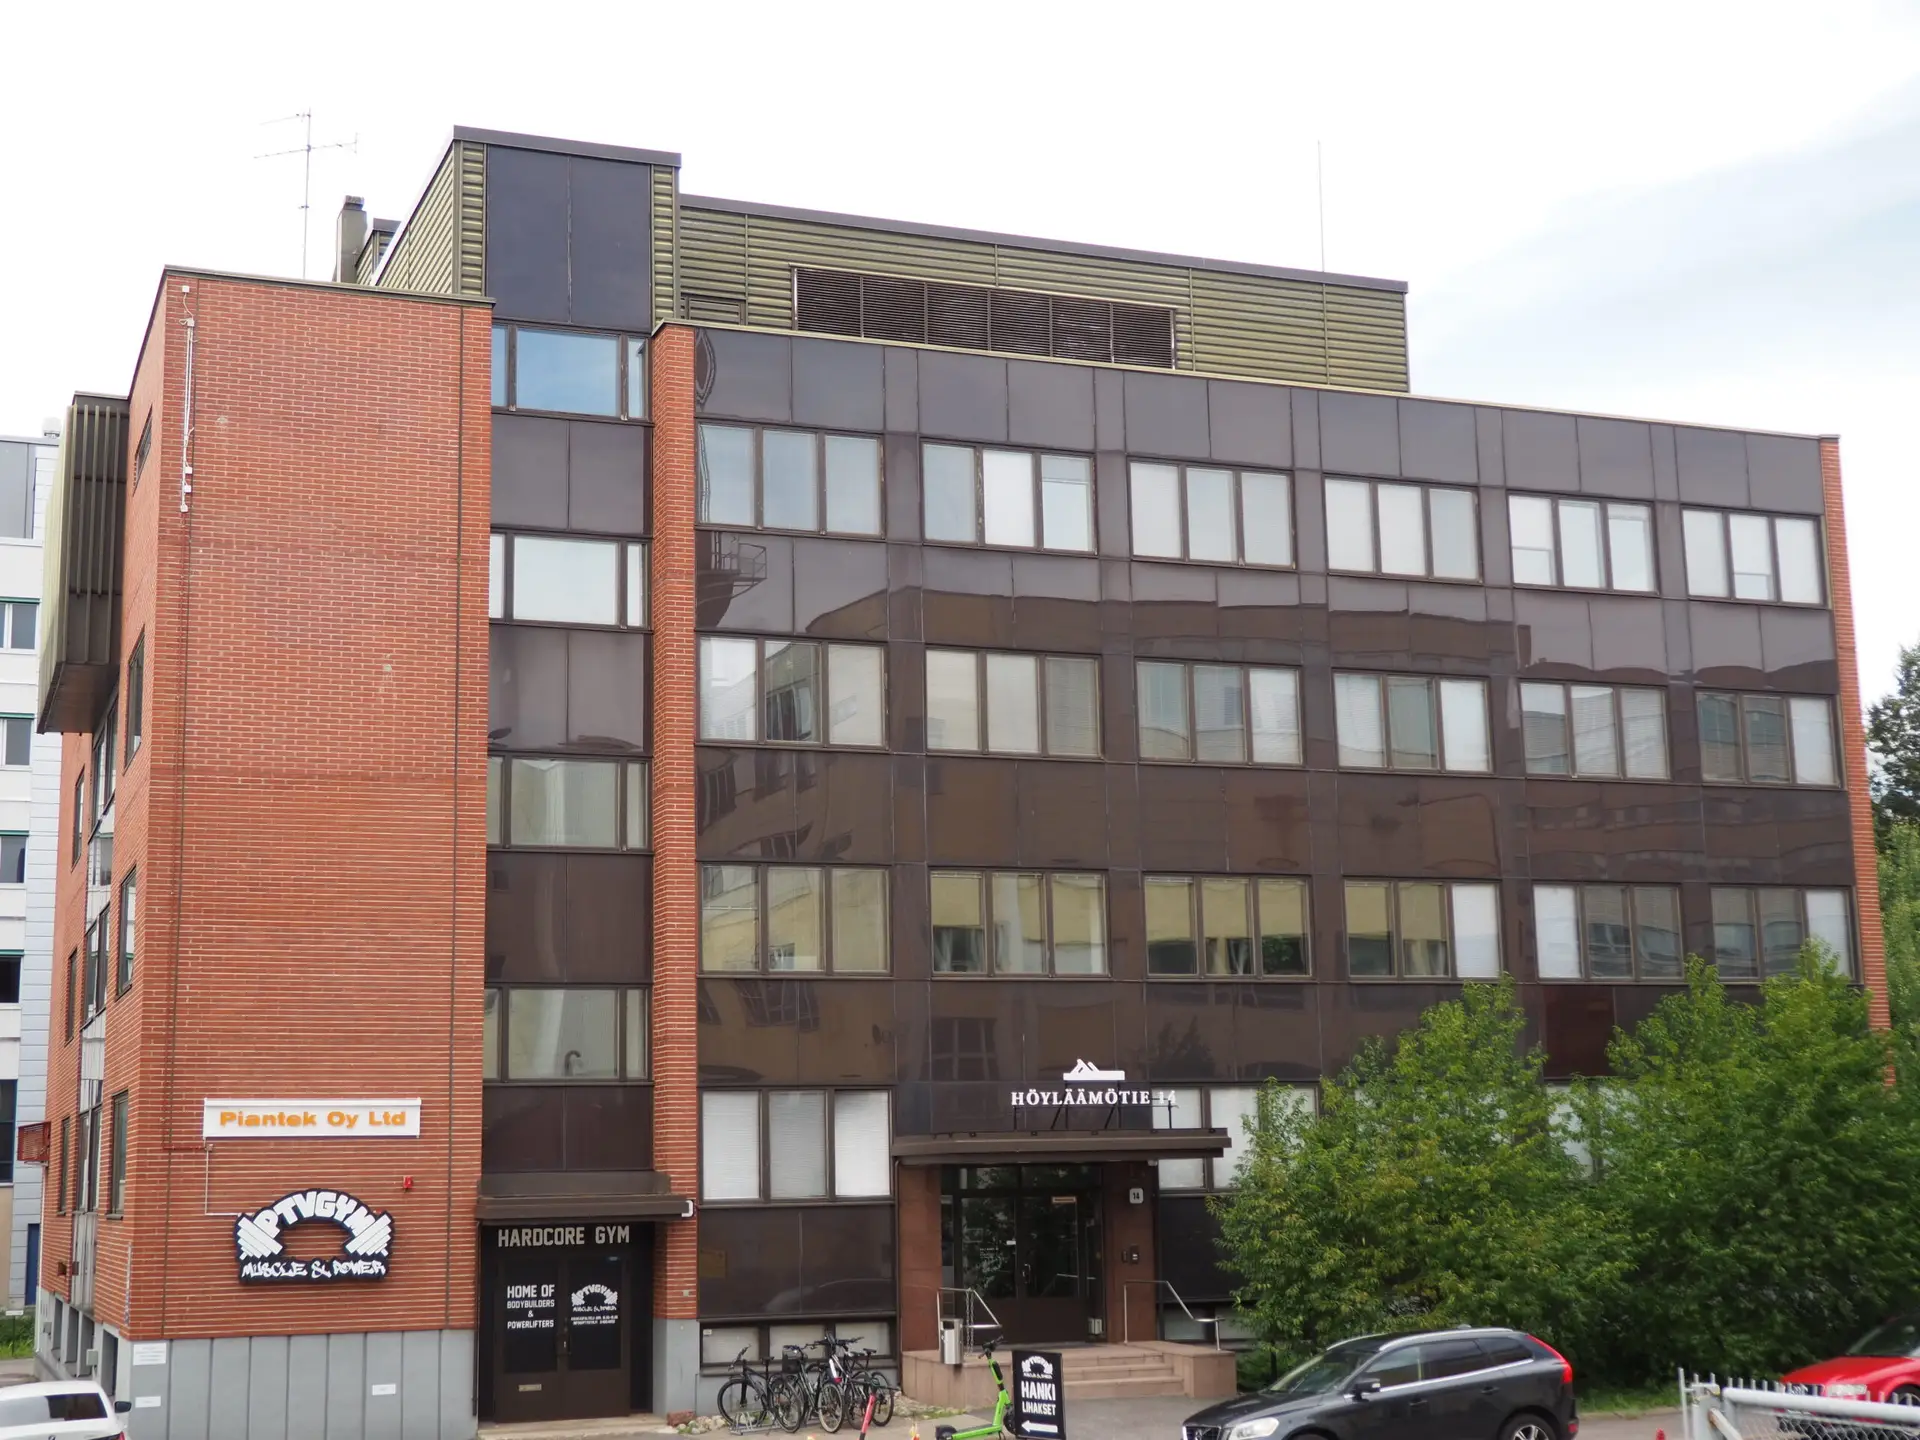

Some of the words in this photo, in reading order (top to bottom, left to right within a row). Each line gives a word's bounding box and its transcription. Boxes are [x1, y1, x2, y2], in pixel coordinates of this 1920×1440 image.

[1011, 1088, 1150, 1106] HÖYLÄÄMÖTIE
[1159, 1090, 1176, 1105] 14
[219, 1111, 317, 1127] Piantek
[327, 1111, 359, 1129] Oy
[368, 1111, 407, 1126] Ltd
[1132, 1191, 1140, 1201] 14
[498, 1226, 585, 1247] HARDCORE
[595, 1225, 630, 1244] GYM
[241, 1261, 308, 1279] MUSCLE
[311, 1260, 332, 1279] &
[332, 1260, 386, 1277] POWER
[507, 1285, 538, 1299] HOME
[541, 1284, 555, 1297] OF
[506, 1299, 555, 1309] BODYBUILDERS
[527, 1310, 534, 1318] &
[507, 1319, 555, 1330] POWERLIFTERS
[1021, 1380, 1057, 1401] HANKI
[1022, 1400, 1057, 1416] LIHAKSET
